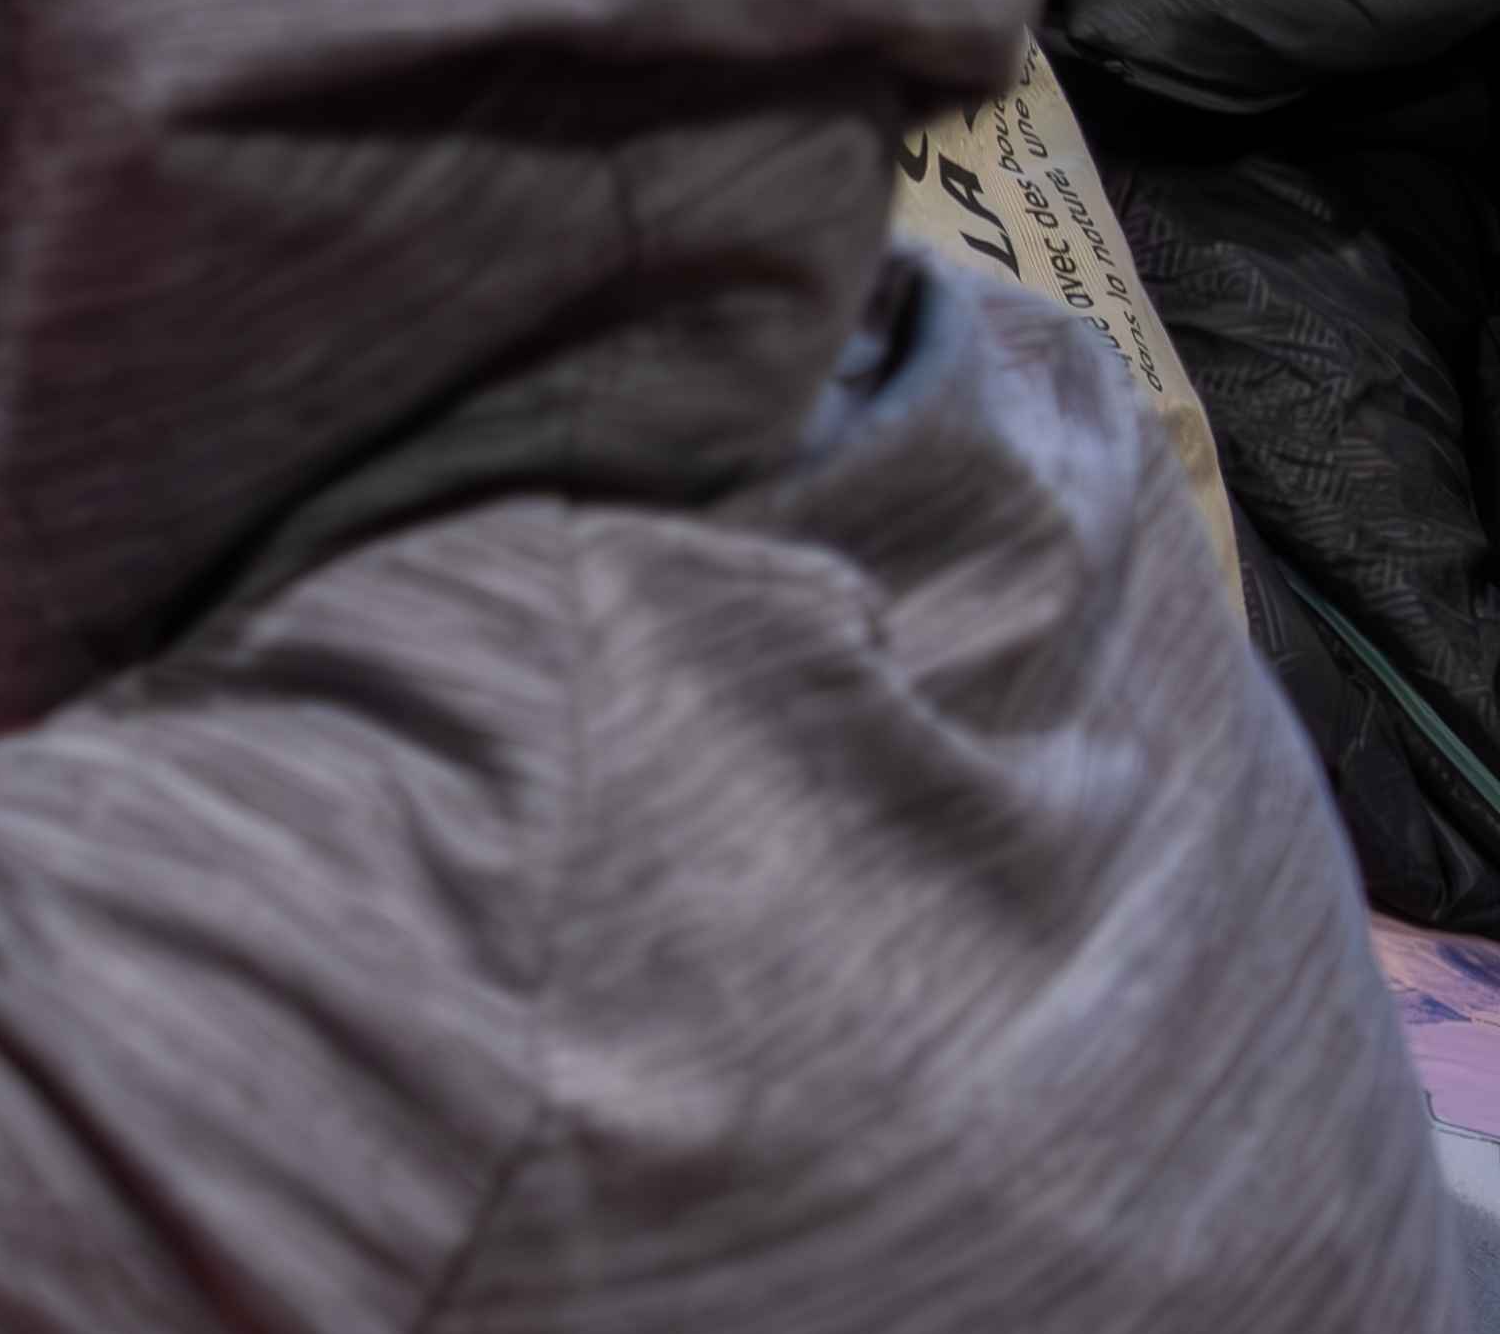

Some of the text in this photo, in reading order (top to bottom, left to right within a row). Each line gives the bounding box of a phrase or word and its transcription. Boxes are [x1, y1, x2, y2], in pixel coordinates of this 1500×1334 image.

[1015, 97, 1049, 160] une
[938, 152, 1023, 282] LA
[1017, 179, 1058, 229] des
[1046, 239, 1094, 309] avec
[1108, 272, 1132, 307] la
[1124, 310, 1163, 393] dans
